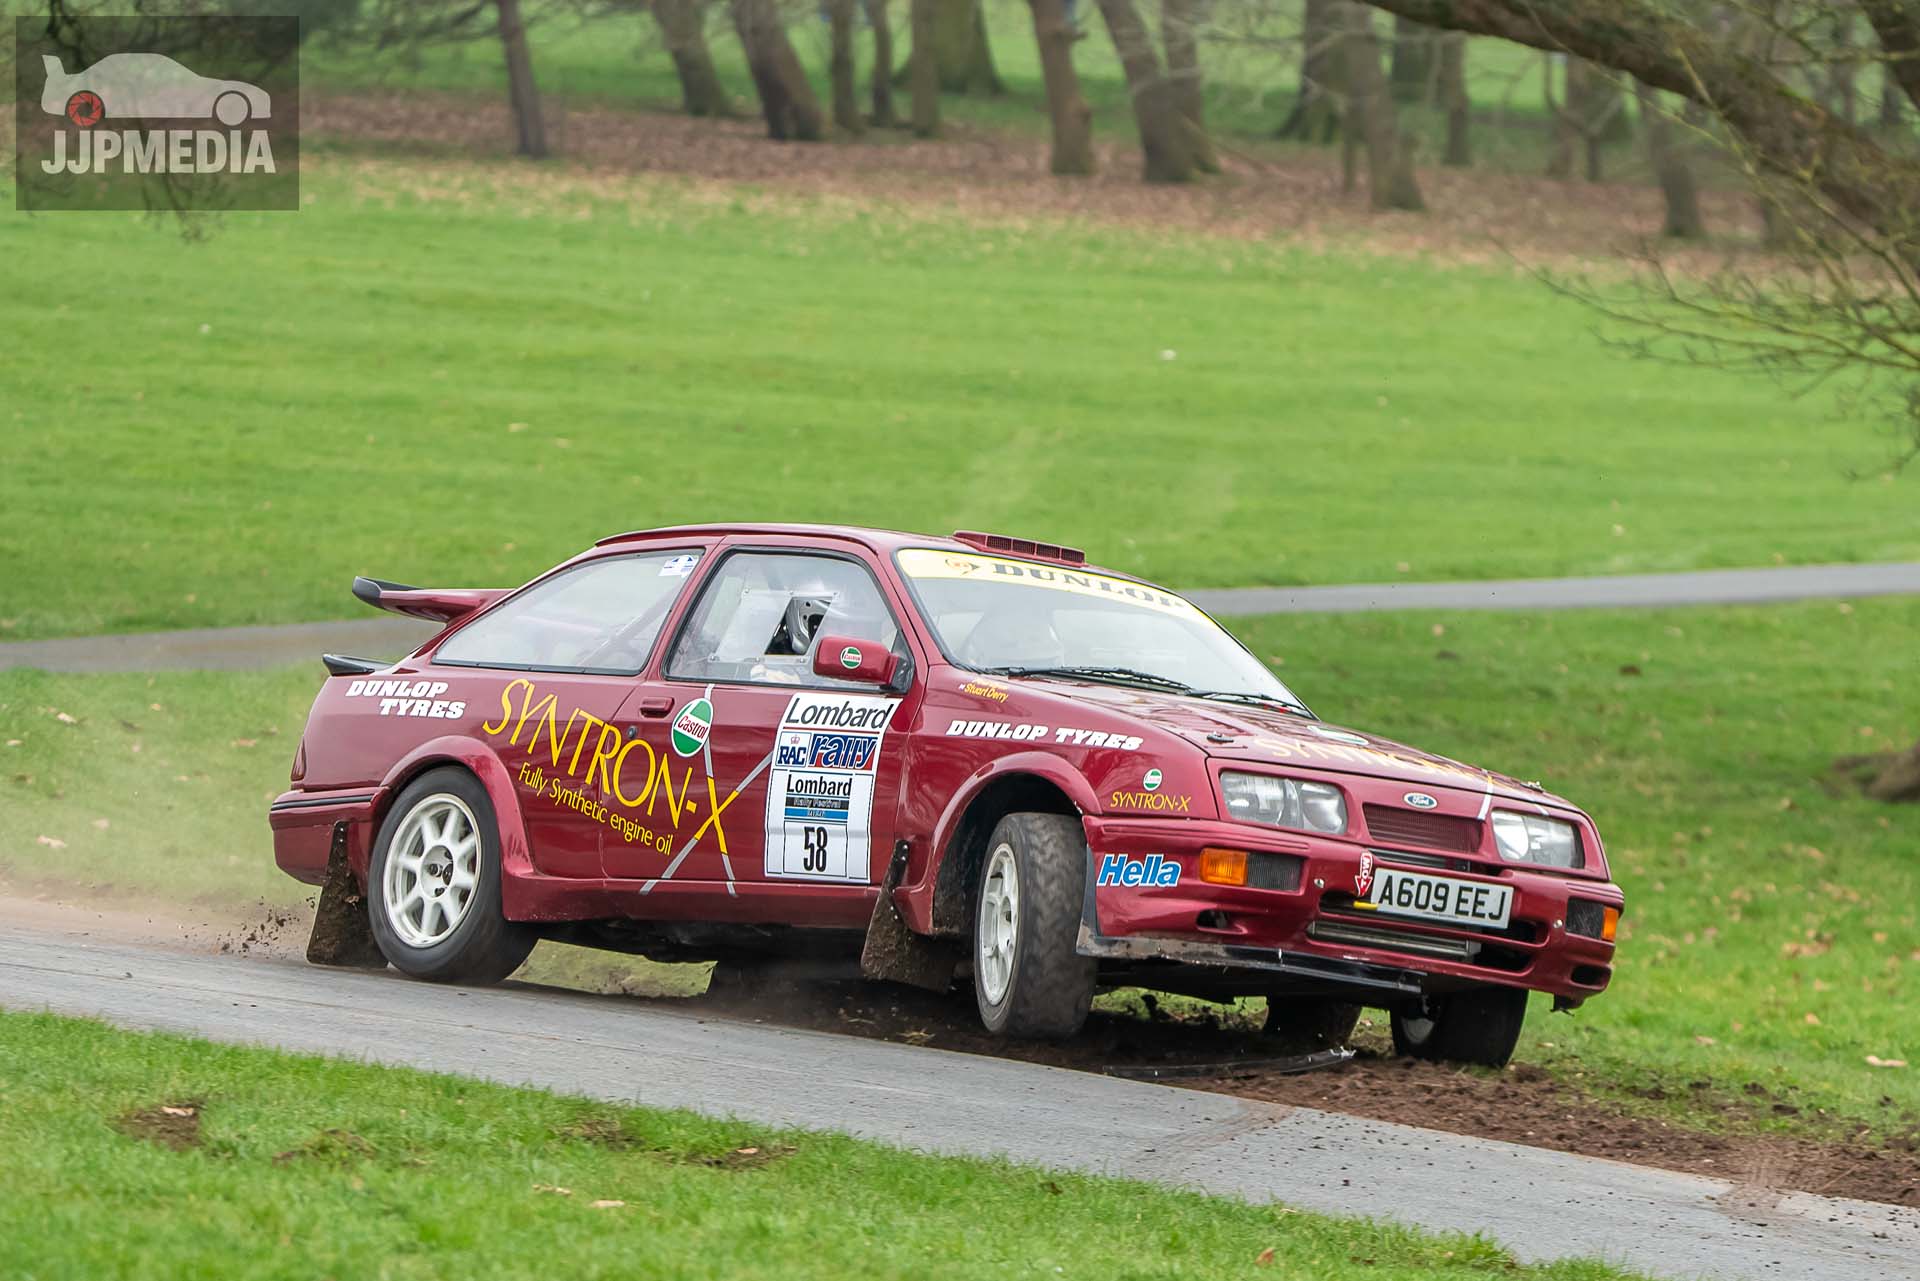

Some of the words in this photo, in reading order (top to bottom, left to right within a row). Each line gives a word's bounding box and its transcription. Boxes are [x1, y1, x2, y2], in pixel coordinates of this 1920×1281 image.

[991, 562, 1184, 607] DUNLOP
[345, 680, 449, 698] DUNLOP
[964, 683, 988, 697] Stuart
[987, 687, 1009, 703] Derry
[379, 698, 467, 719] TYRES
[785, 697, 894, 729] Lombard
[677, 714, 709, 739] Castrol
[945, 719, 1049, 741] DUNLOP
[1055, 727, 1144, 750] TYRES
[777, 745, 807, 766] RAC
[808, 736, 877, 769] rally
[786, 774, 853, 796] Lombard
[518, 761, 548, 797] Fully
[549, 777, 608, 823] Synthetic
[610, 813, 653, 846] engine
[655, 834, 674, 856] oil
[803, 826, 828, 872] 58
[1096, 853, 1182, 887] Hella
[1360, 854, 1373, 889] TOW
[1378, 874, 1450, 912] A609
[1454, 885, 1507, 921] EEJ
